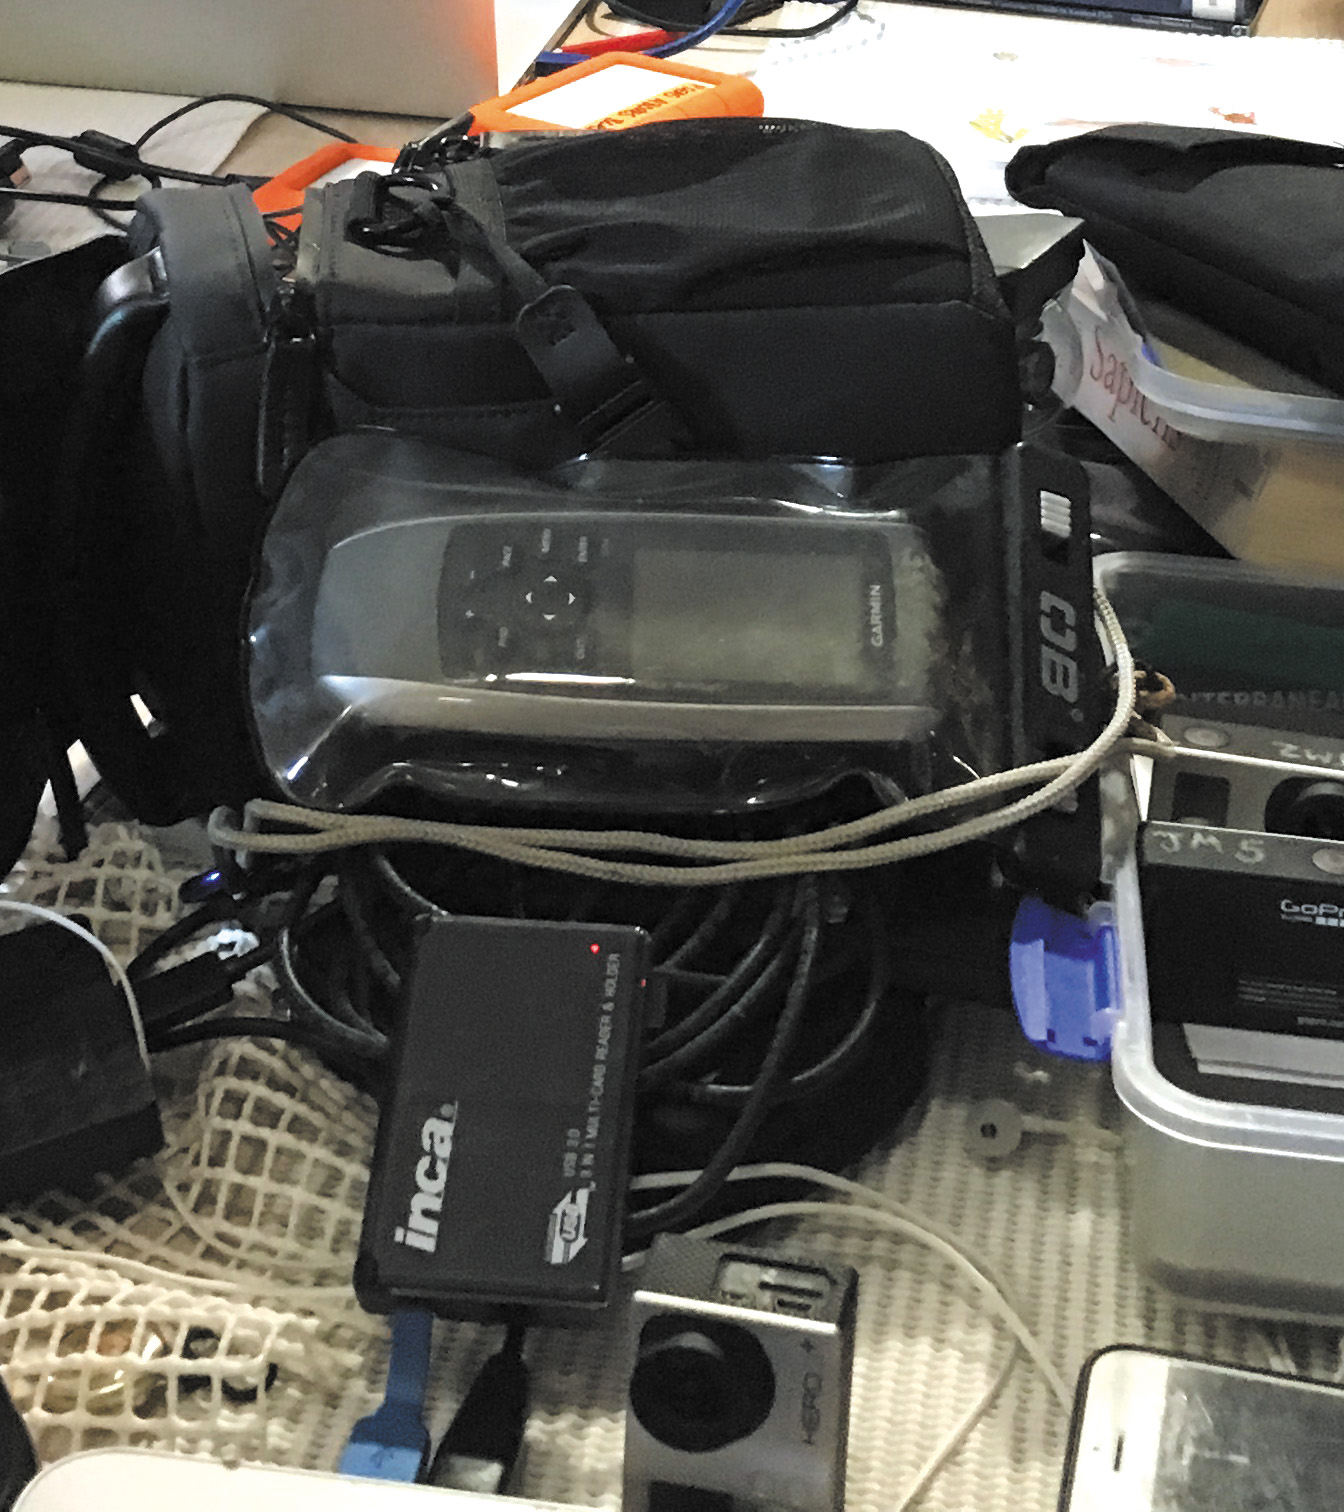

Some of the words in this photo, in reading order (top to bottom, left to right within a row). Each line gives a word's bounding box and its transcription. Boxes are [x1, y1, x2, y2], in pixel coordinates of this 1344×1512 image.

[869, 583, 882, 648] GARMIN
[594, 1015, 613, 1061] READER
[605, 953, 621, 998] HOLDER
